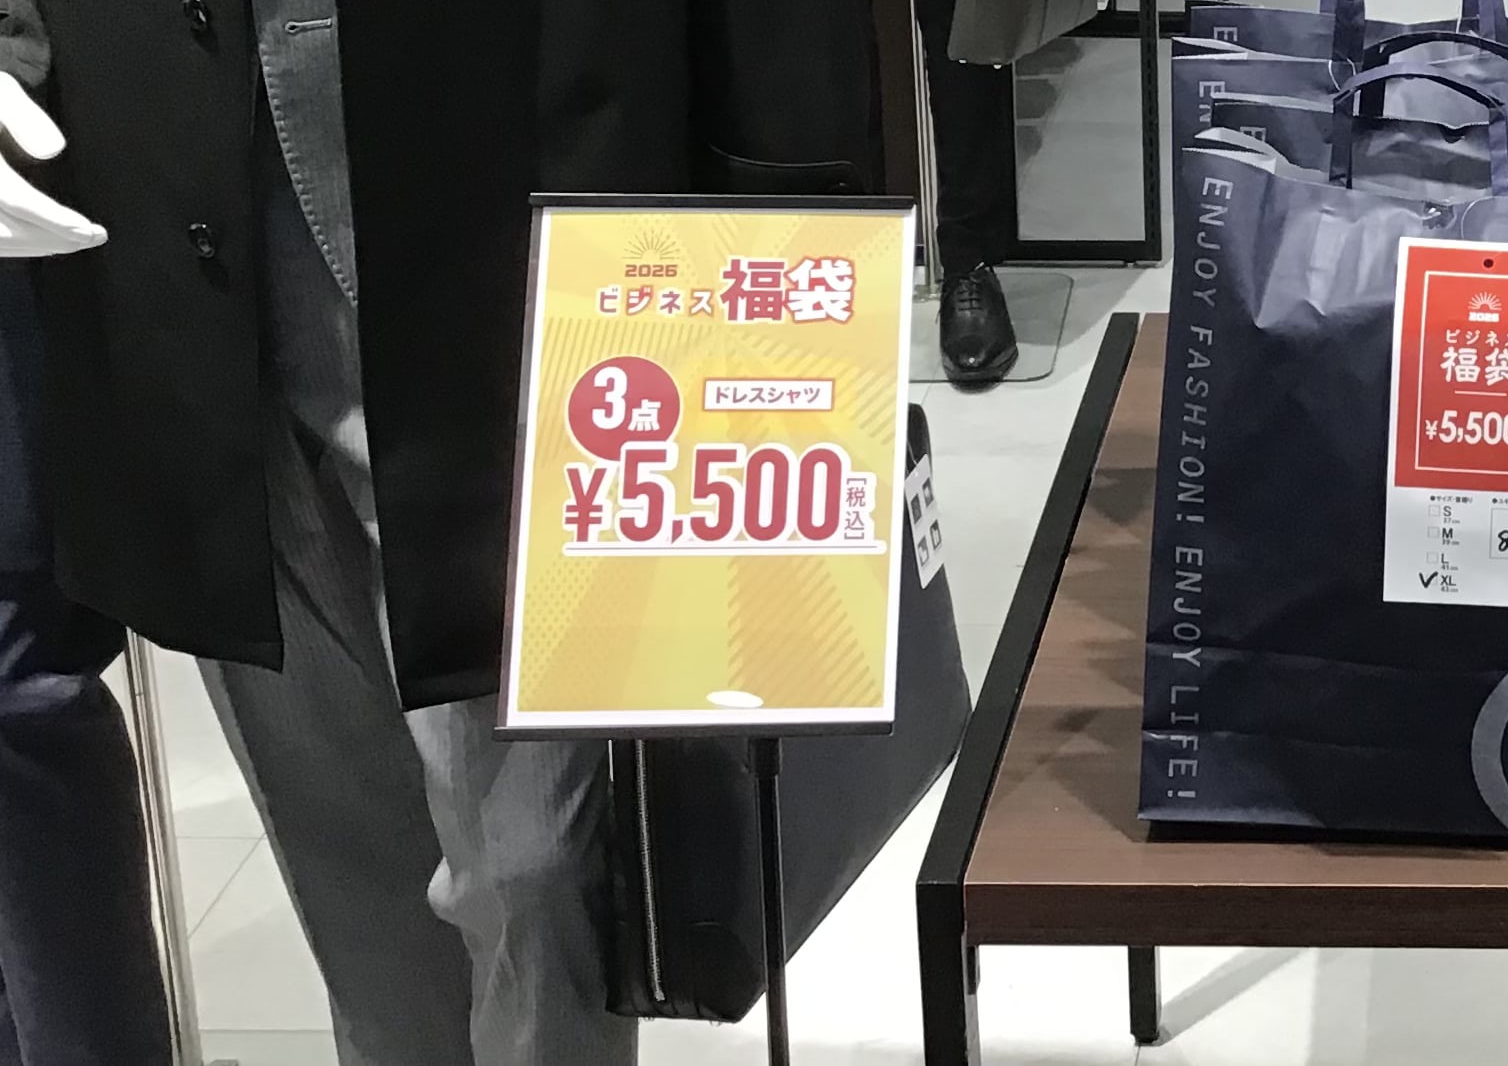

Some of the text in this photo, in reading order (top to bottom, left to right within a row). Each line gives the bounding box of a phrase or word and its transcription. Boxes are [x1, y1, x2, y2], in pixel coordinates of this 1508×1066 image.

[625, 264, 678, 278] 2026
[599, 258, 854, 323] ビジネス 福袋
[716, 386, 821, 404] ドレスシャツ
[1167, 176, 1233, 799] ENJOY FASHION! ENJOY LIFE!
[1443, 505, 1452, 517] S
[1442, 528, 1453, 539] M
[1441, 553, 1449, 564] L
[1440, 575, 1457, 586] XL
